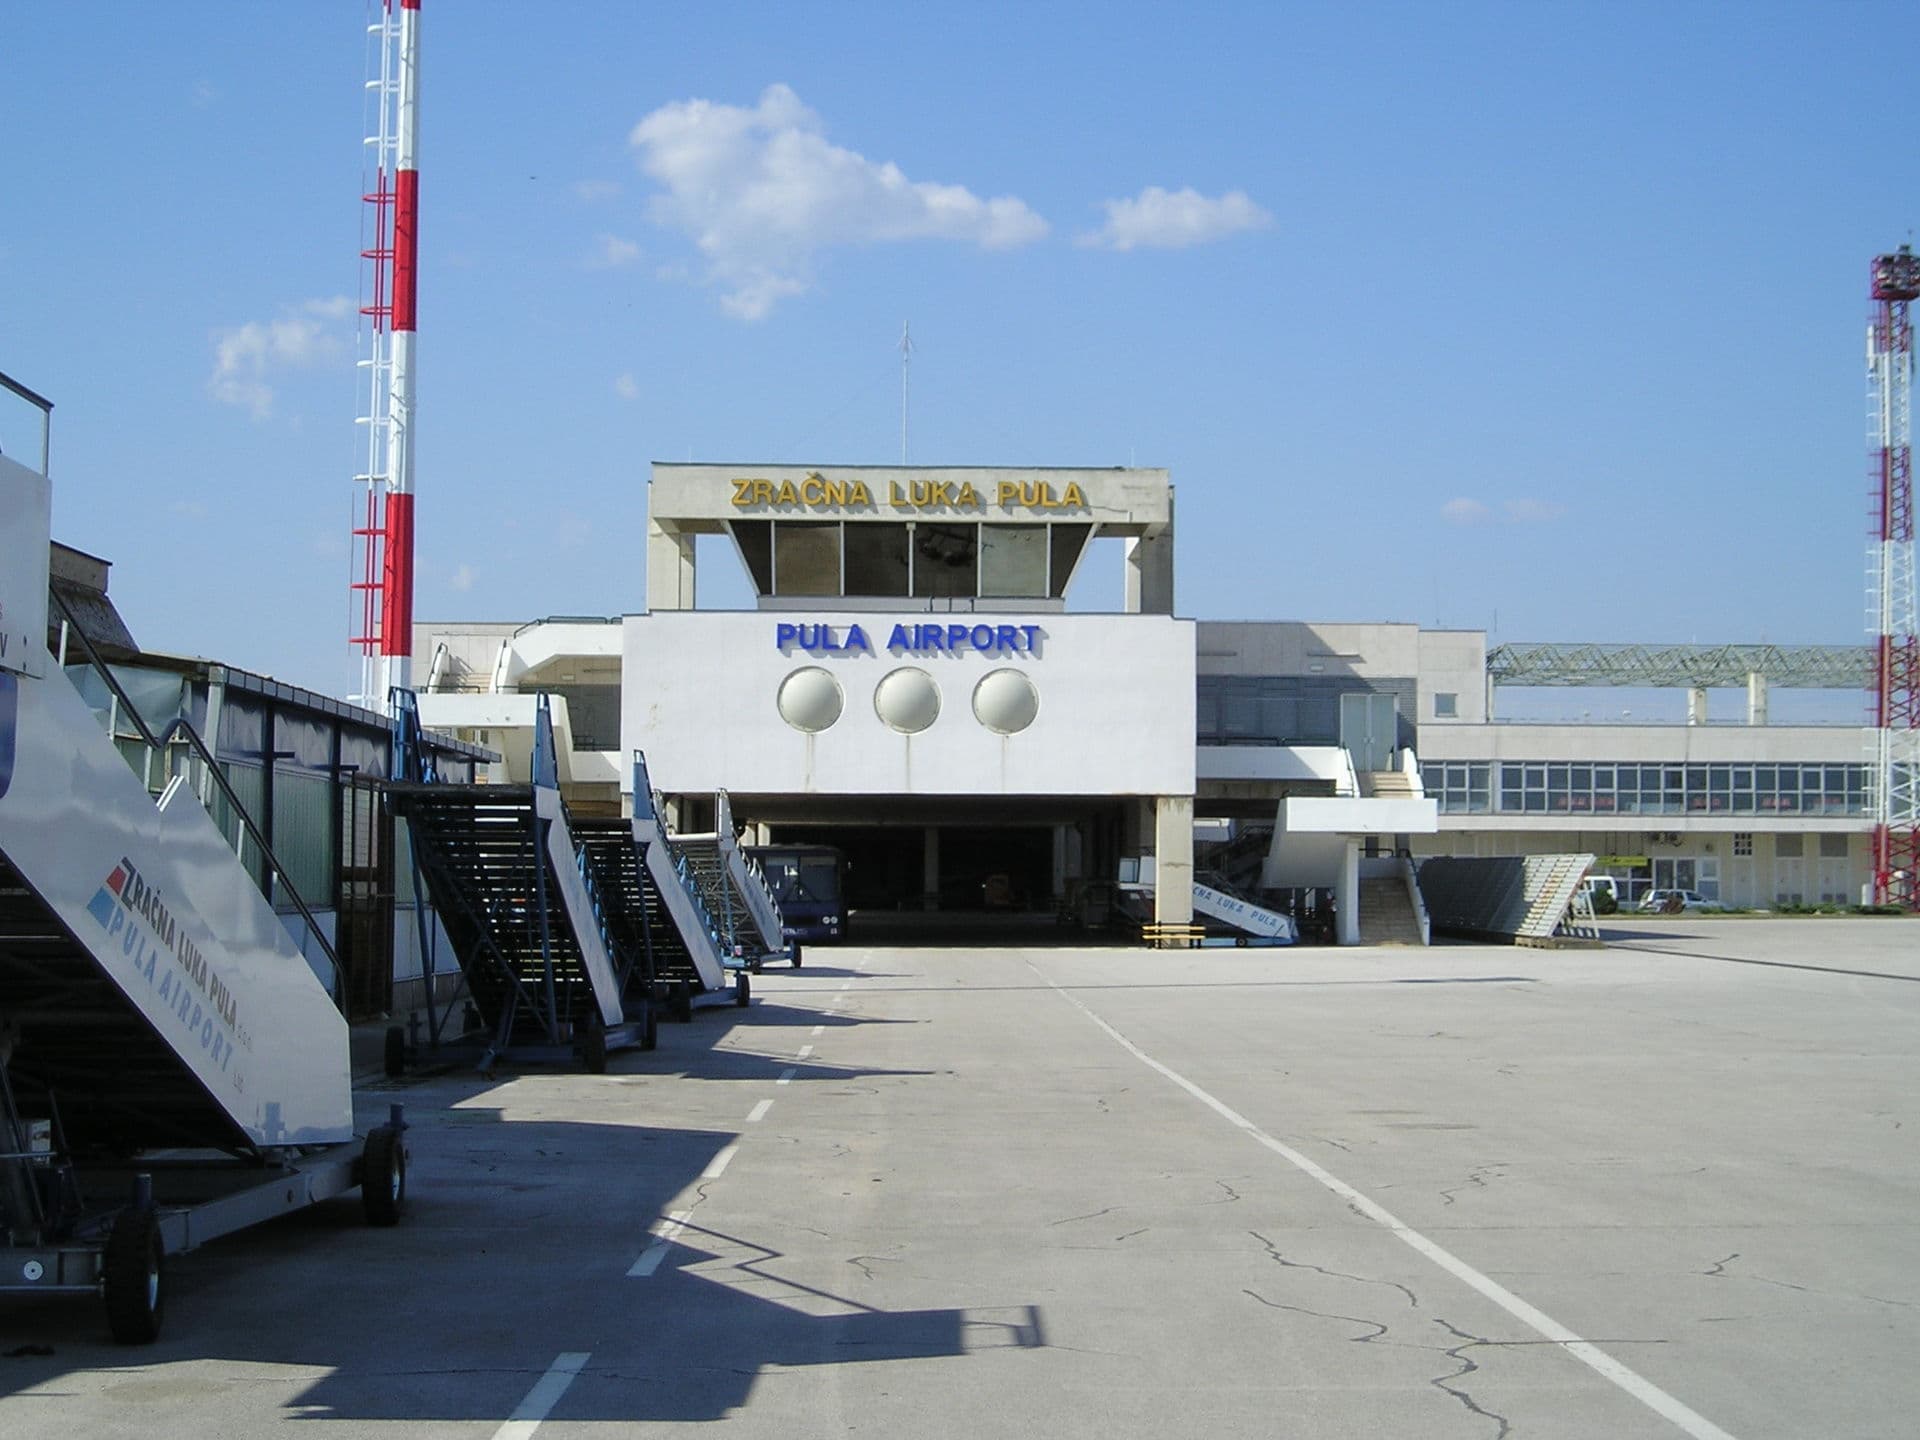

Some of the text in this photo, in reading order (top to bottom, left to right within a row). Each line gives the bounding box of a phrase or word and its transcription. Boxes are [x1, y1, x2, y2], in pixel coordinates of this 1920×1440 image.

[731, 472, 1084, 508] ZRAČNA LUKA PULA
[777, 623, 1040, 651] PULA AIRPORT
[1216, 895, 1244, 912] LUKA
[1250, 910, 1277, 928] PULA
[121, 857, 236, 1032] ZRAČNA LUKA PULA
[109, 905, 233, 1072] PULA AIRPORT
